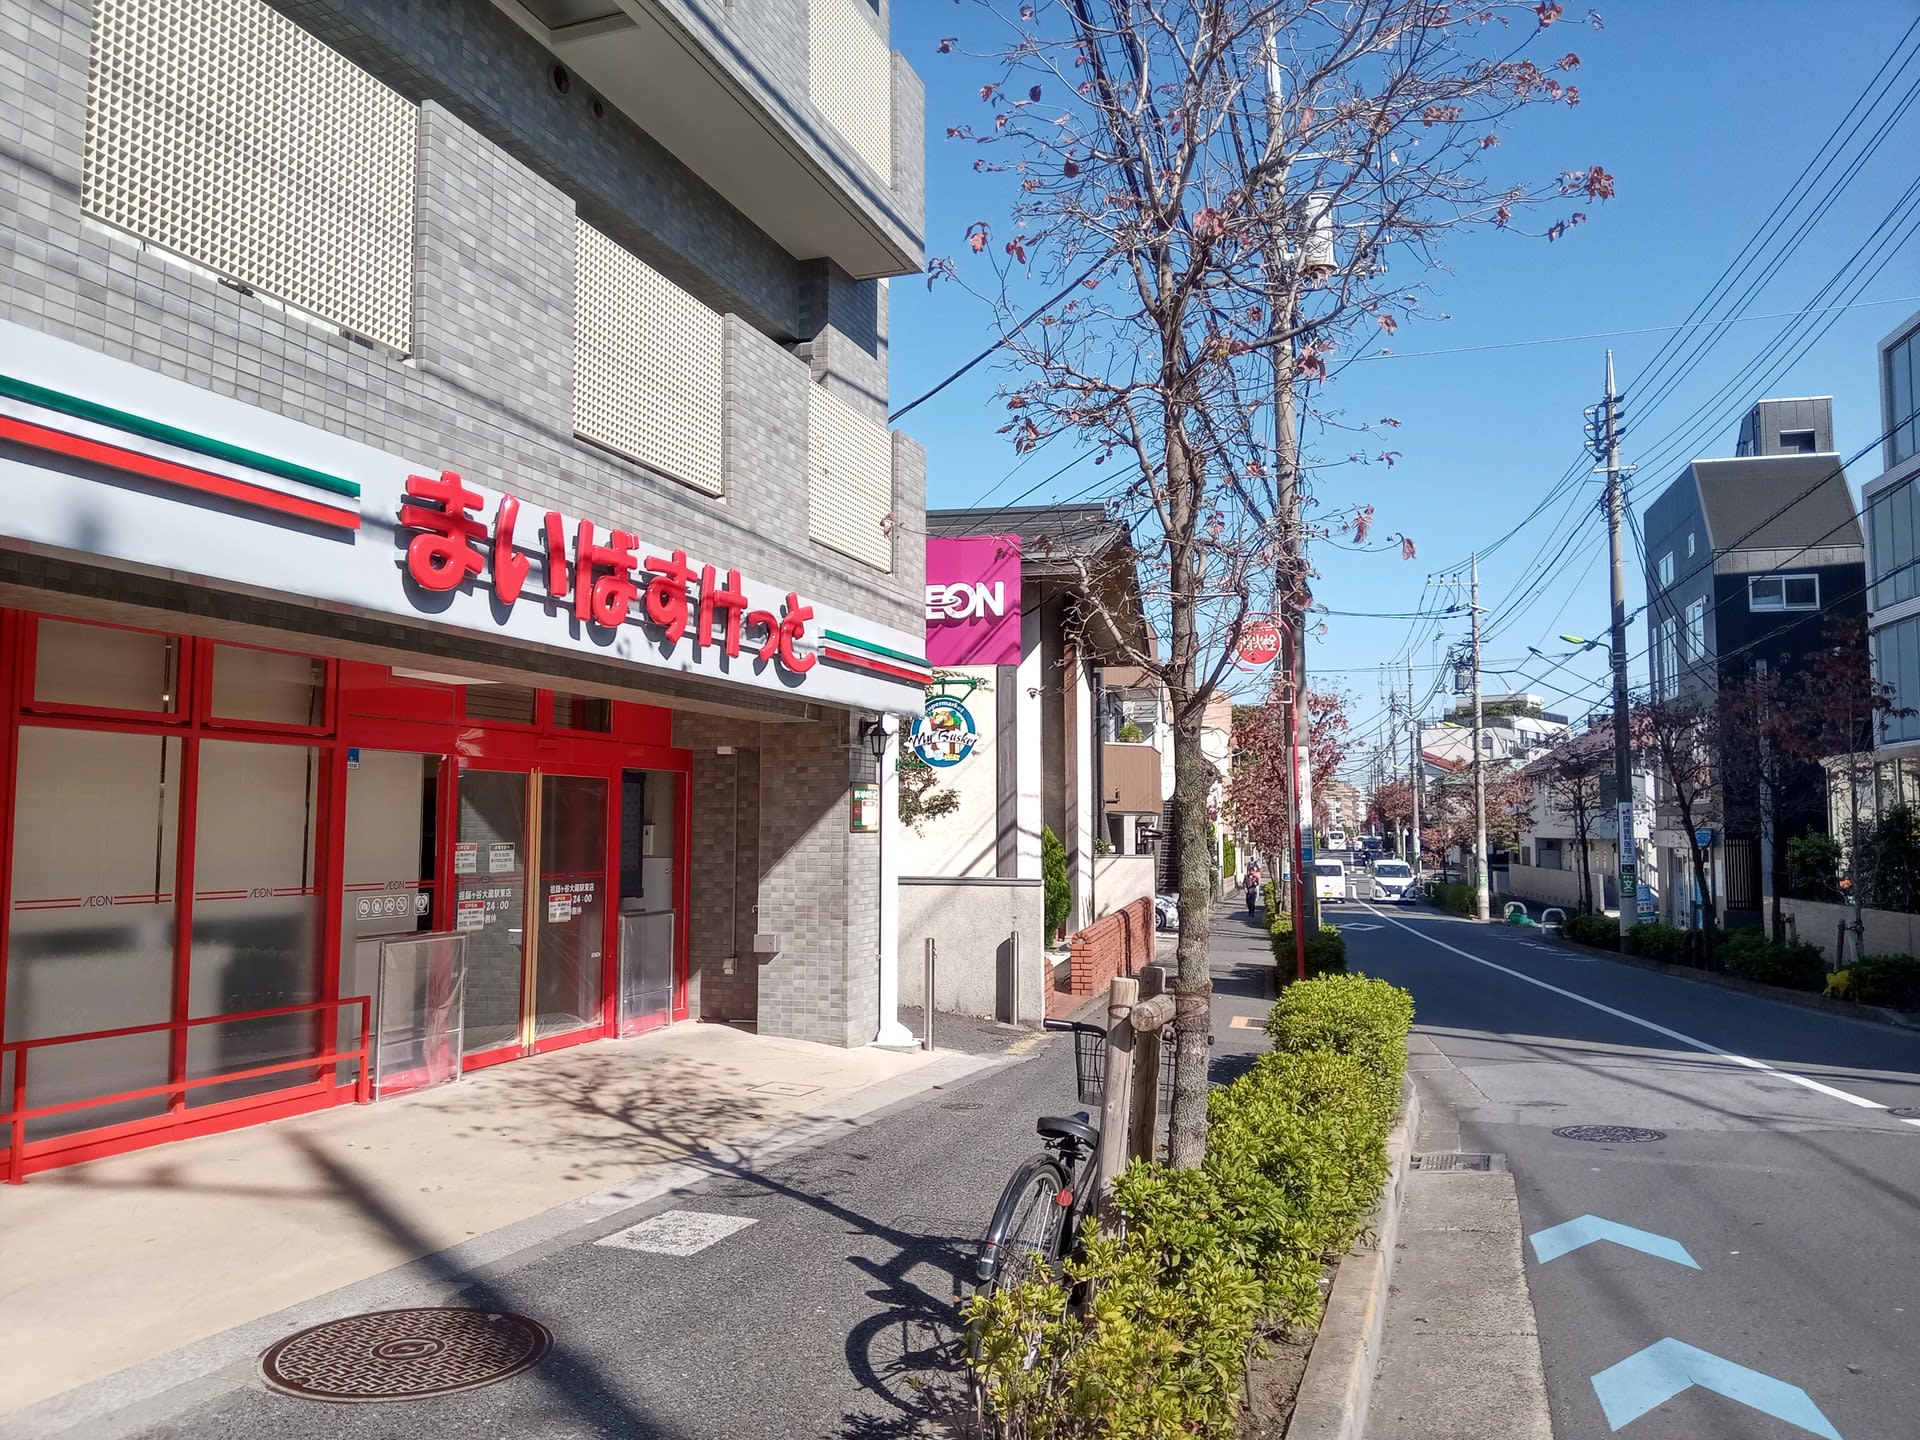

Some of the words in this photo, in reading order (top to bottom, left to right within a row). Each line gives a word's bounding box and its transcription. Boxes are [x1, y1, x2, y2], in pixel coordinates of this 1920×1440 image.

[400, 470, 817, 674] まいばすけっと
[925, 581, 1004, 620] EON
[908, 731, 933, 745] My
